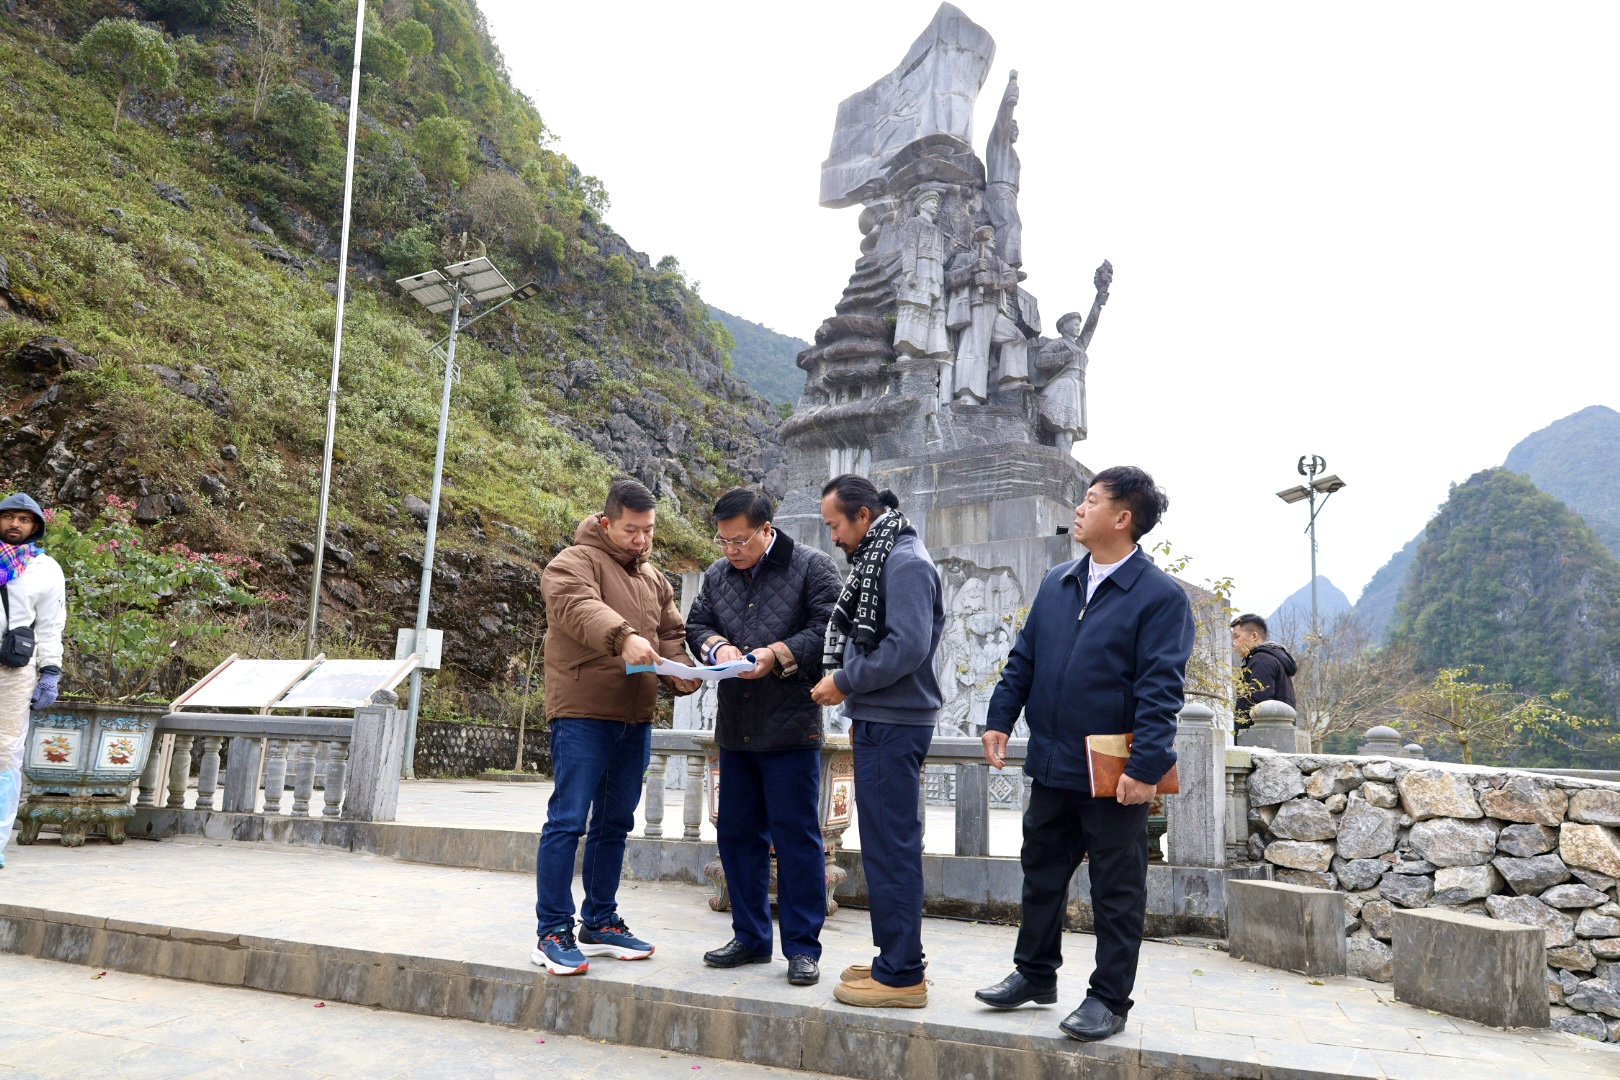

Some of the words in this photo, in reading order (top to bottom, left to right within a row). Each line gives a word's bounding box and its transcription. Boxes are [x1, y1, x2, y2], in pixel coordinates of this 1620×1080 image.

[881, 529, 889, 537] G
[876, 540, 884, 548] G
[870, 552, 879, 560] G
[866, 565, 874, 573] G
[863, 578, 871, 588] G
[842, 591, 852, 602] G
[861, 592, 869, 602] G
[859, 608, 867, 617] G
